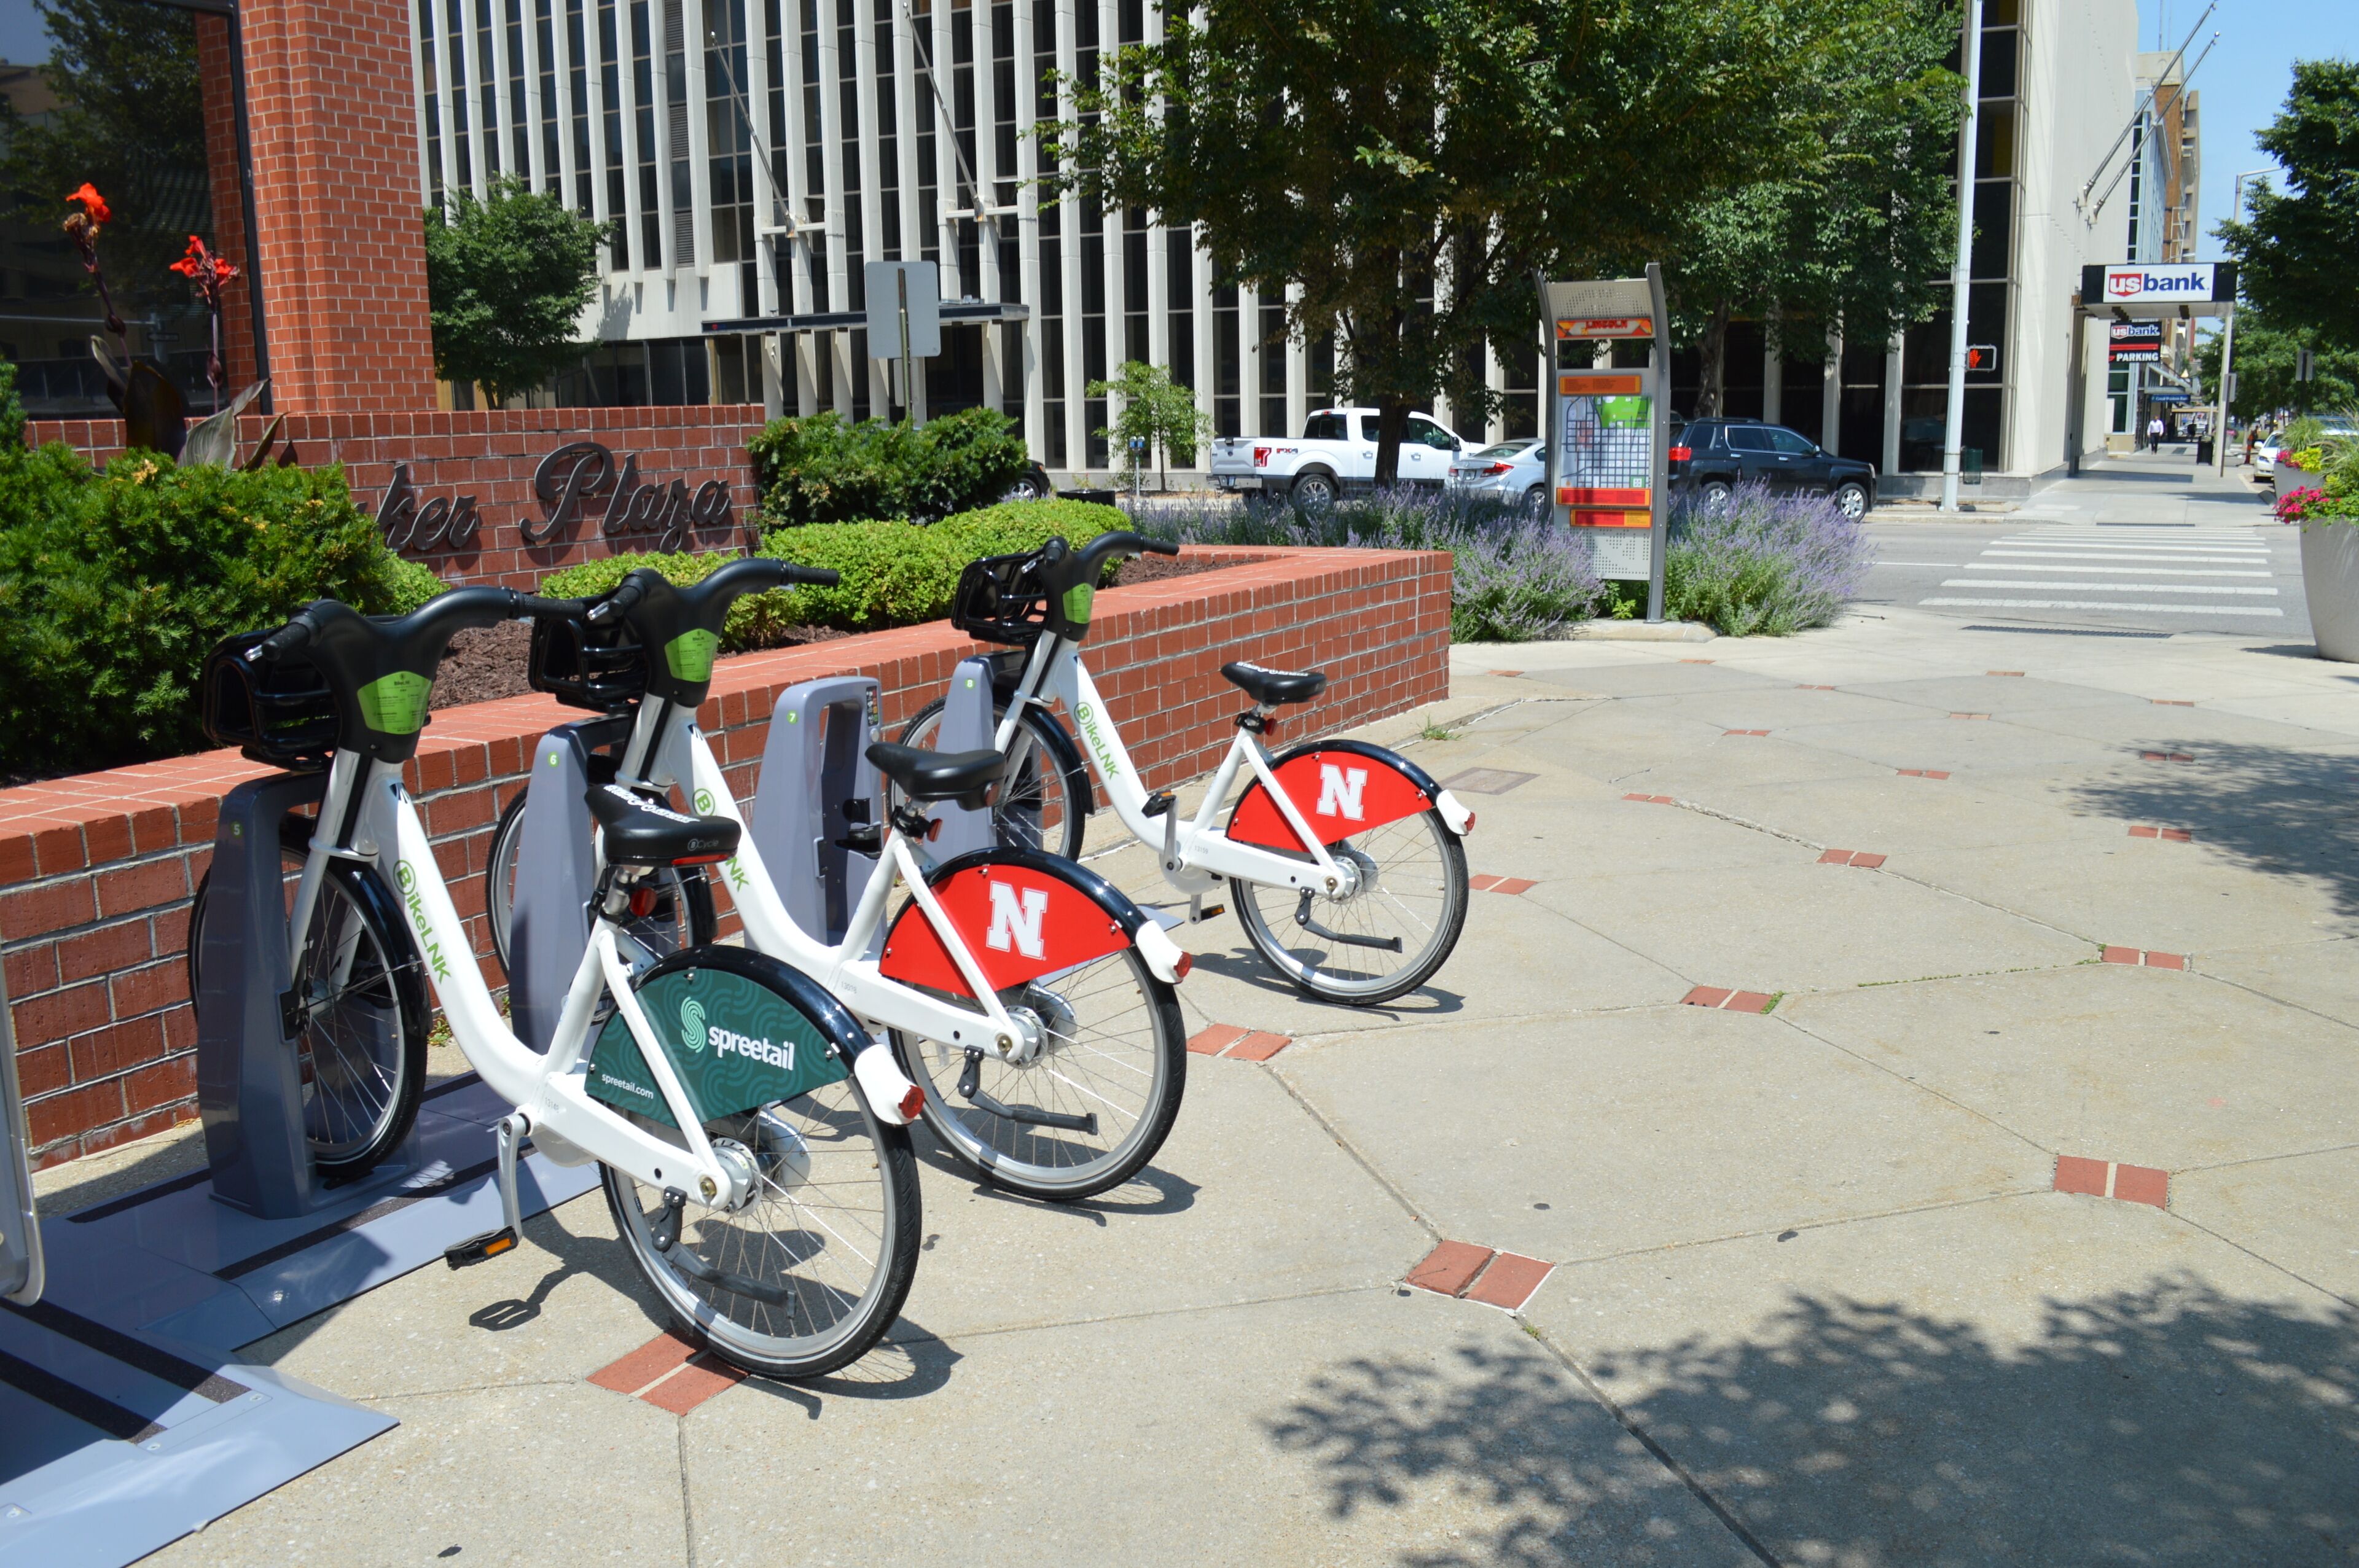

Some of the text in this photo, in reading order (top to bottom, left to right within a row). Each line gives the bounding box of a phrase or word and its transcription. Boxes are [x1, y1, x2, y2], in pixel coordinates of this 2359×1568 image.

[2116, 352, 2159, 362] PARKING
[356, 442, 732, 553] ker Plaza
[1074, 702, 1119, 780] BikeLNK
[1316, 763, 1368, 822] N
[393, 860, 452, 985] BikeLNK
[986, 880, 1048, 960] N
[708, 1026, 795, 1071] spreetail
[601, 1072, 654, 1099] spreetail.com
